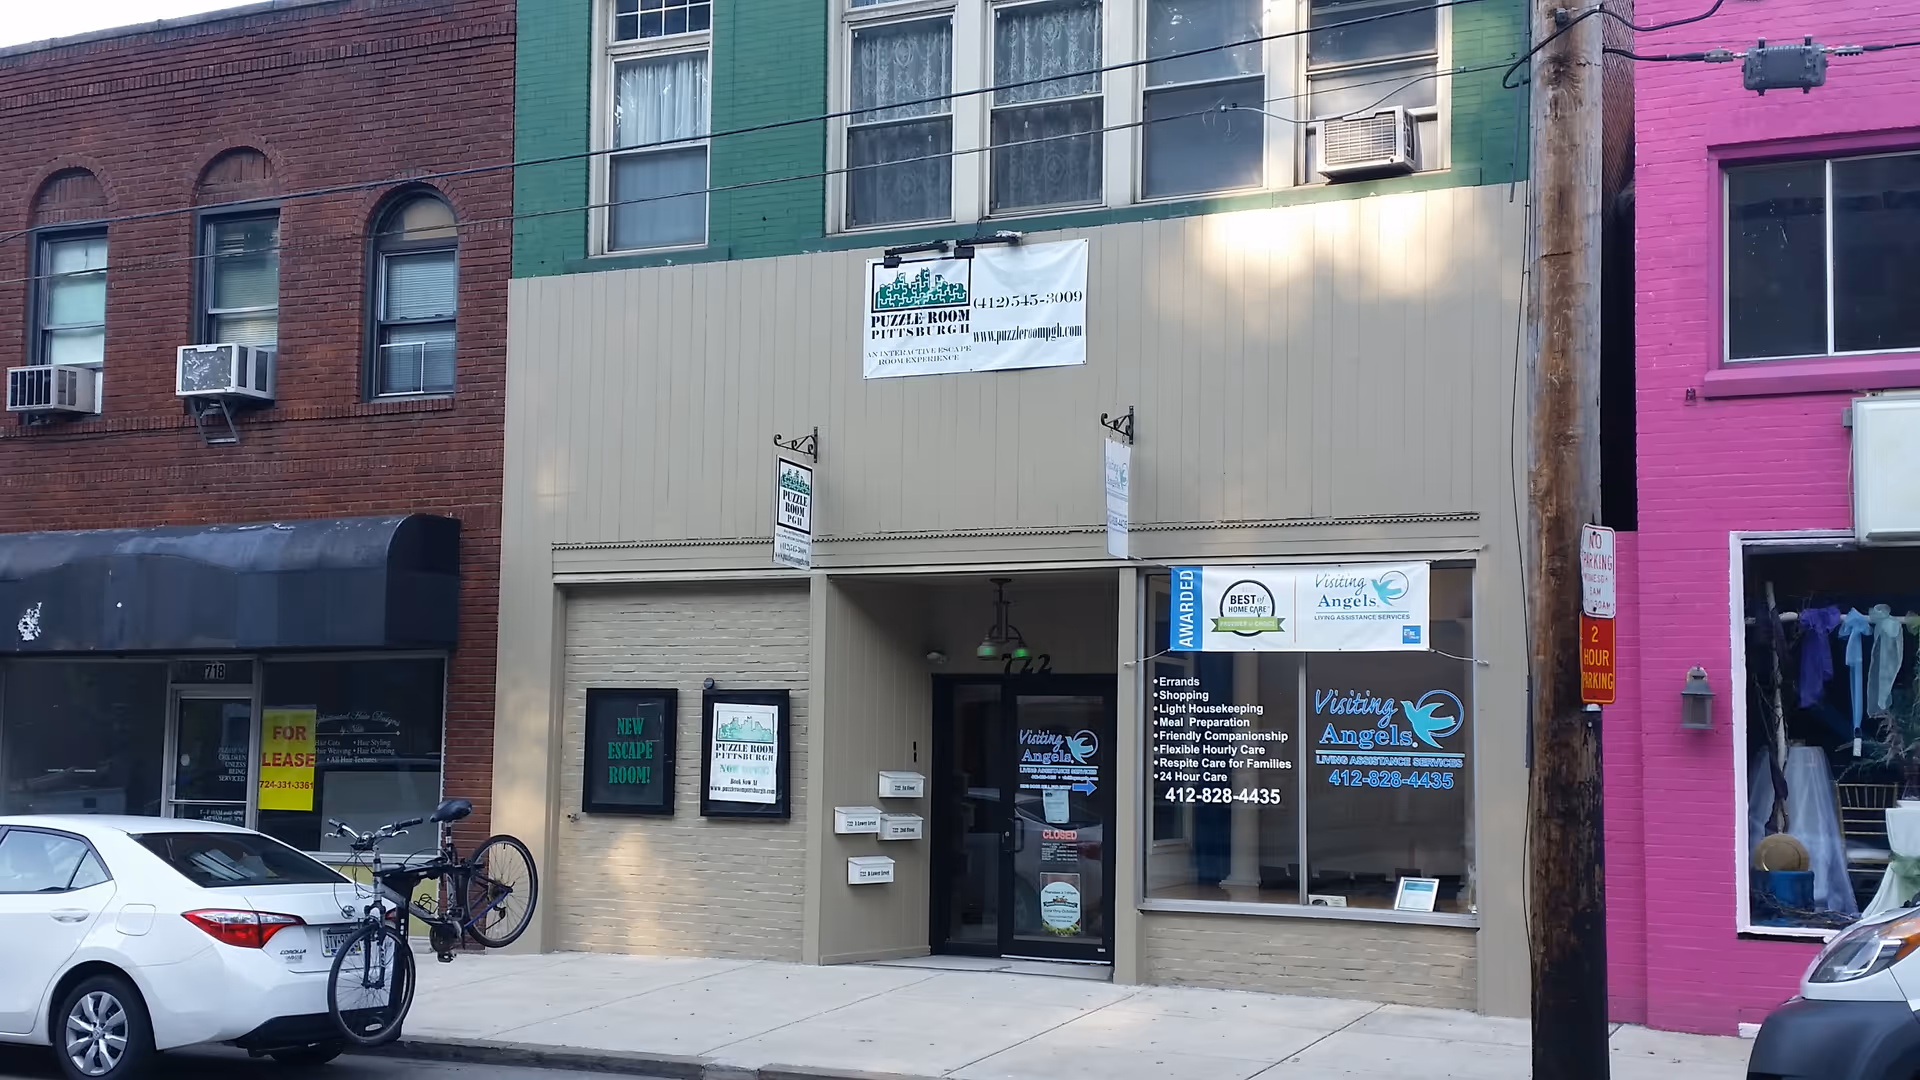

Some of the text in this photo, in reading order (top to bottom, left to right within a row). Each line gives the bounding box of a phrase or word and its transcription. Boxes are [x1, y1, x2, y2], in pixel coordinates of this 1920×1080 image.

[973, 290, 1083, 309] (412)545-3009
[871, 309, 970, 328] PUZZLE ROOM
[871, 323, 970, 340] PITTSBURGH
[973, 322, 1082, 345] www.puzzleroompgh.com
[880, 347, 936, 357] INTERACTIVE
[938, 345, 972, 354] ESCAPE
[878, 355, 960, 366] ROOM EXPERIENCE
[782, 489, 808, 507] PUZZLE
[785, 501, 805, 518] ROOM
[787, 514, 802, 526] PGH
[1589, 532, 1602, 549] NO
[1583, 551, 1613, 571] PARKING
[1315, 572, 1367, 596] Visiting
[1230, 594, 1266, 605] BEST of
[1178, 570, 1194, 648] AWARDED
[1228, 605, 1267, 614] HOME CARE
[1591, 625, 1599, 643] 2
[1002, 652, 1053, 677] 722
[1583, 648, 1610, 666] HOUR
[205, 664, 226, 679] 718
[1159, 676, 1200, 687] Errands
[1582, 671, 1614, 690] PARKING
[1159, 690, 1209, 702] Shopping
[1159, 703, 1264, 716] Light Housekeeping
[1315, 688, 1399, 729] Visiting
[617, 717, 644, 735] NEW
[1159, 717, 1250, 729] Meal Preparation
[272, 725, 307, 741] FOR
[1019, 729, 1065, 753] Visiting
[1159, 731, 1289, 743] Friendly Companionship
[607, 741, 653, 759] ESCAPE
[715, 743, 774, 754] PUZZLE ROOM
[715, 752, 774, 762] PITTSBURGH
[1159, 744, 1266, 756] Flexible Hourly Care
[261, 752, 316, 768] LEASE
[1159, 757, 1292, 769] Respite Care for Families
[1316, 755, 1463, 768] LIVING ASSISTANCE SERVICES
[608, 766, 651, 784] ROOM!
[1159, 771, 1228, 782] 24 Hour Care
[1328, 769, 1454, 790] 412-828-4435
[1165, 786, 1281, 804] 412-828-4435
[1042, 829, 1078, 840] CLOSED
